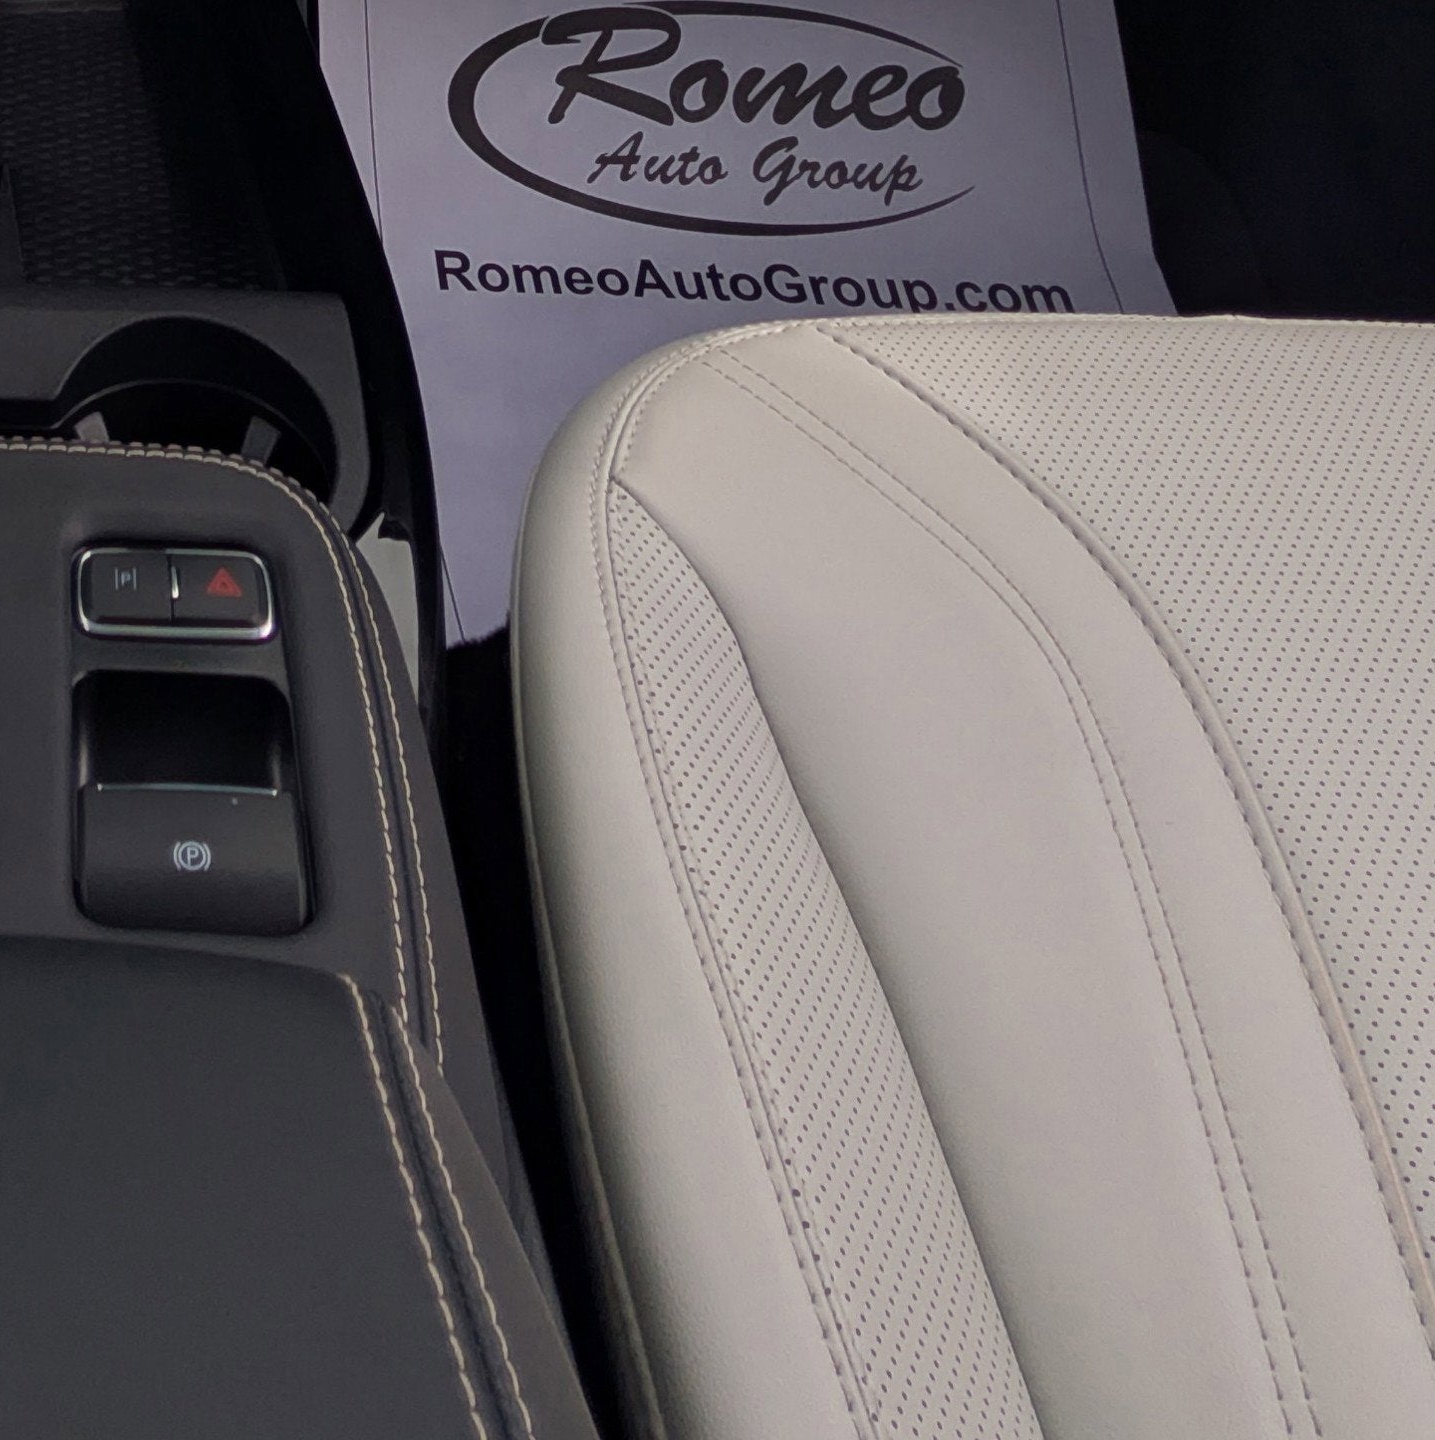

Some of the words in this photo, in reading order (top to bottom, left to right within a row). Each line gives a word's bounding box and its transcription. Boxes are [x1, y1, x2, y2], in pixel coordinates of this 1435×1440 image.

[541, 6, 966, 131] Romeo
[587, 131, 729, 186] Auto
[752, 136, 924, 206] Group
[434, 249, 1075, 314] RomeoAutoGroup.com
